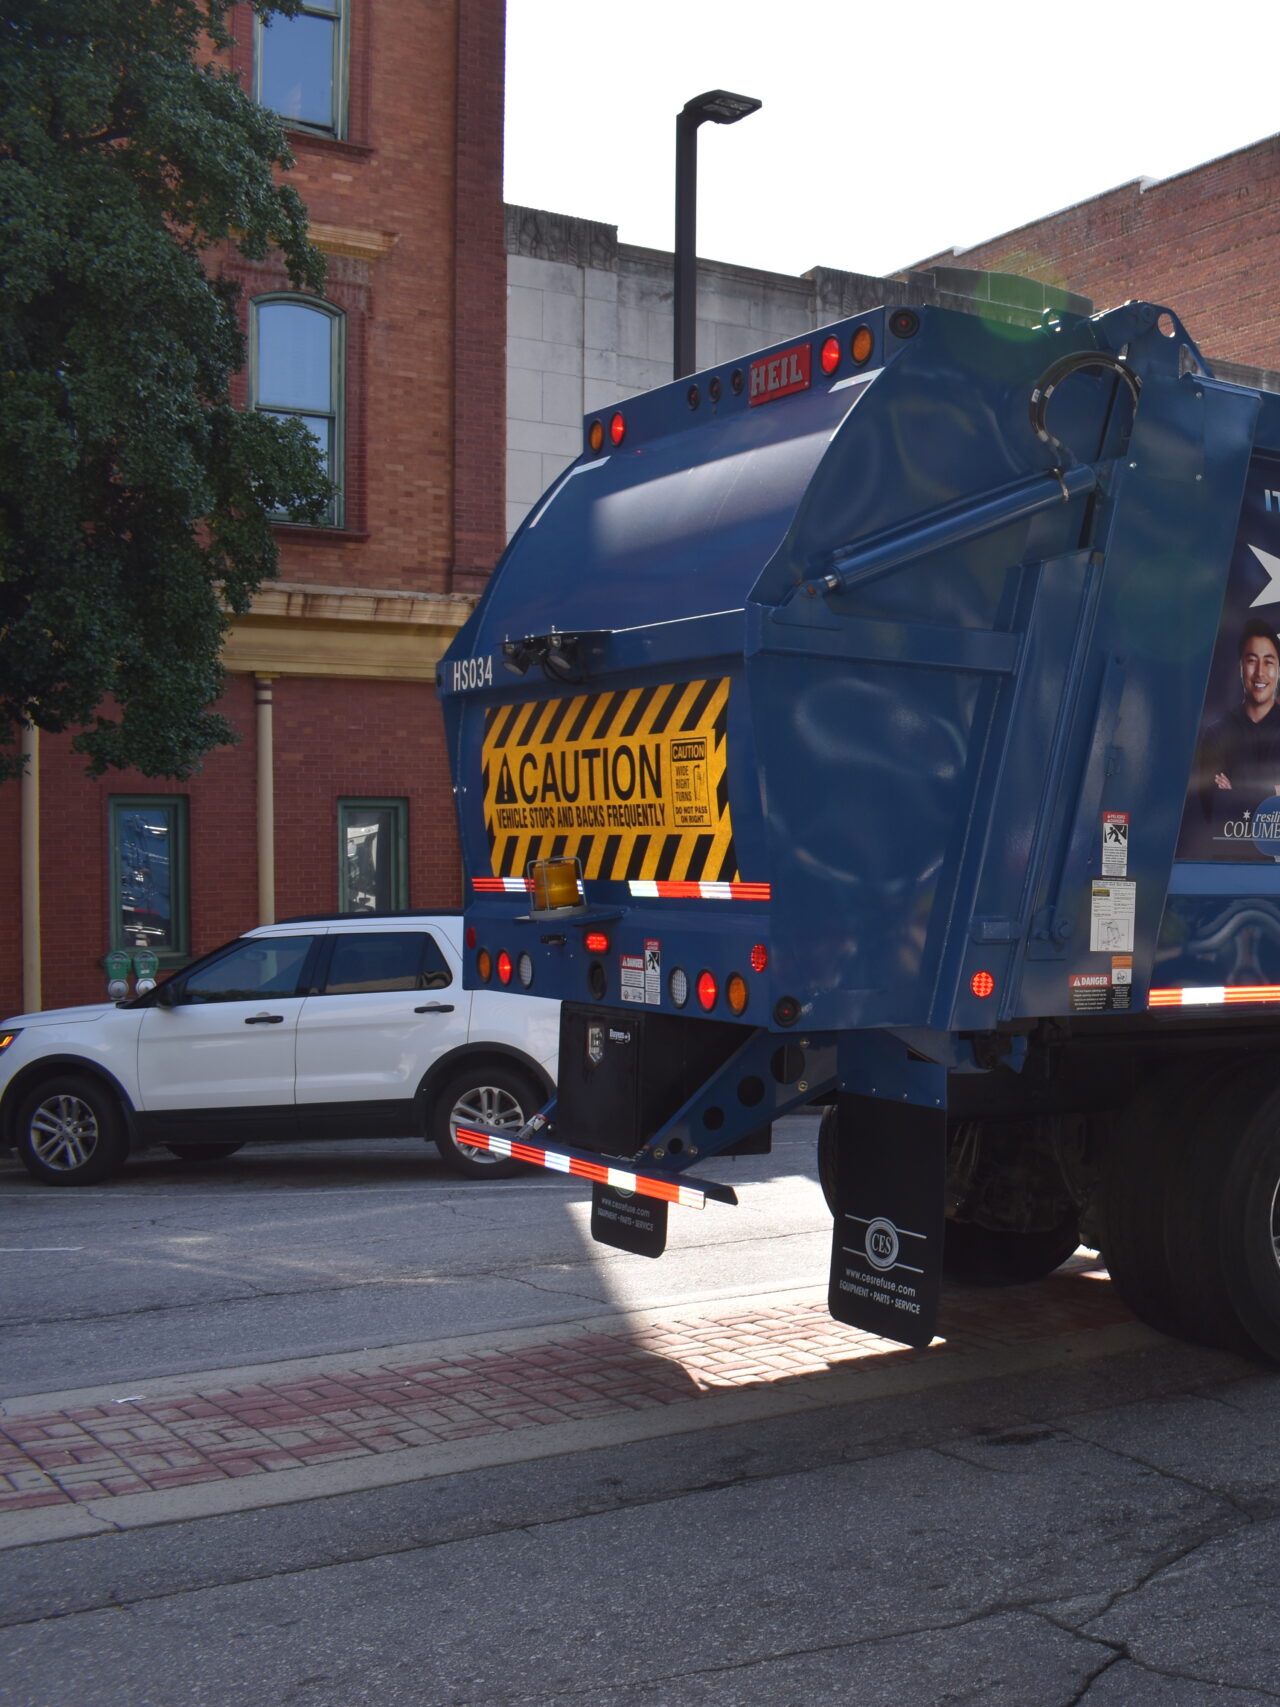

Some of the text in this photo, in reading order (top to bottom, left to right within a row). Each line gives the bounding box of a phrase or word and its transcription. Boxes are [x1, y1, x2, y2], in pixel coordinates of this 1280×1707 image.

[750, 354, 803, 397] HEIL
[454, 655, 493, 691] HS034
[672, 744, 705, 760] CAUTION
[519, 743, 662, 804] CAUTION
[675, 765, 689, 776] WIDE
[675, 778, 690, 789] RIGHT
[675, 791, 692, 802] TURNS
[496, 803, 666, 829] VEHICLE STOPS AND BACKS FREQUENTLY
[675, 806, 708, 815] DO NOT PASS
[680, 815, 704, 823] ON RIGHT
[1081, 976, 1108, 986] DANGER
[871, 1233, 892, 1255] CES
[845, 1268, 916, 1297] www.cesrefuse.com
[839, 1279, 921, 1314] EQUIPMENT PARTS SERVICE
